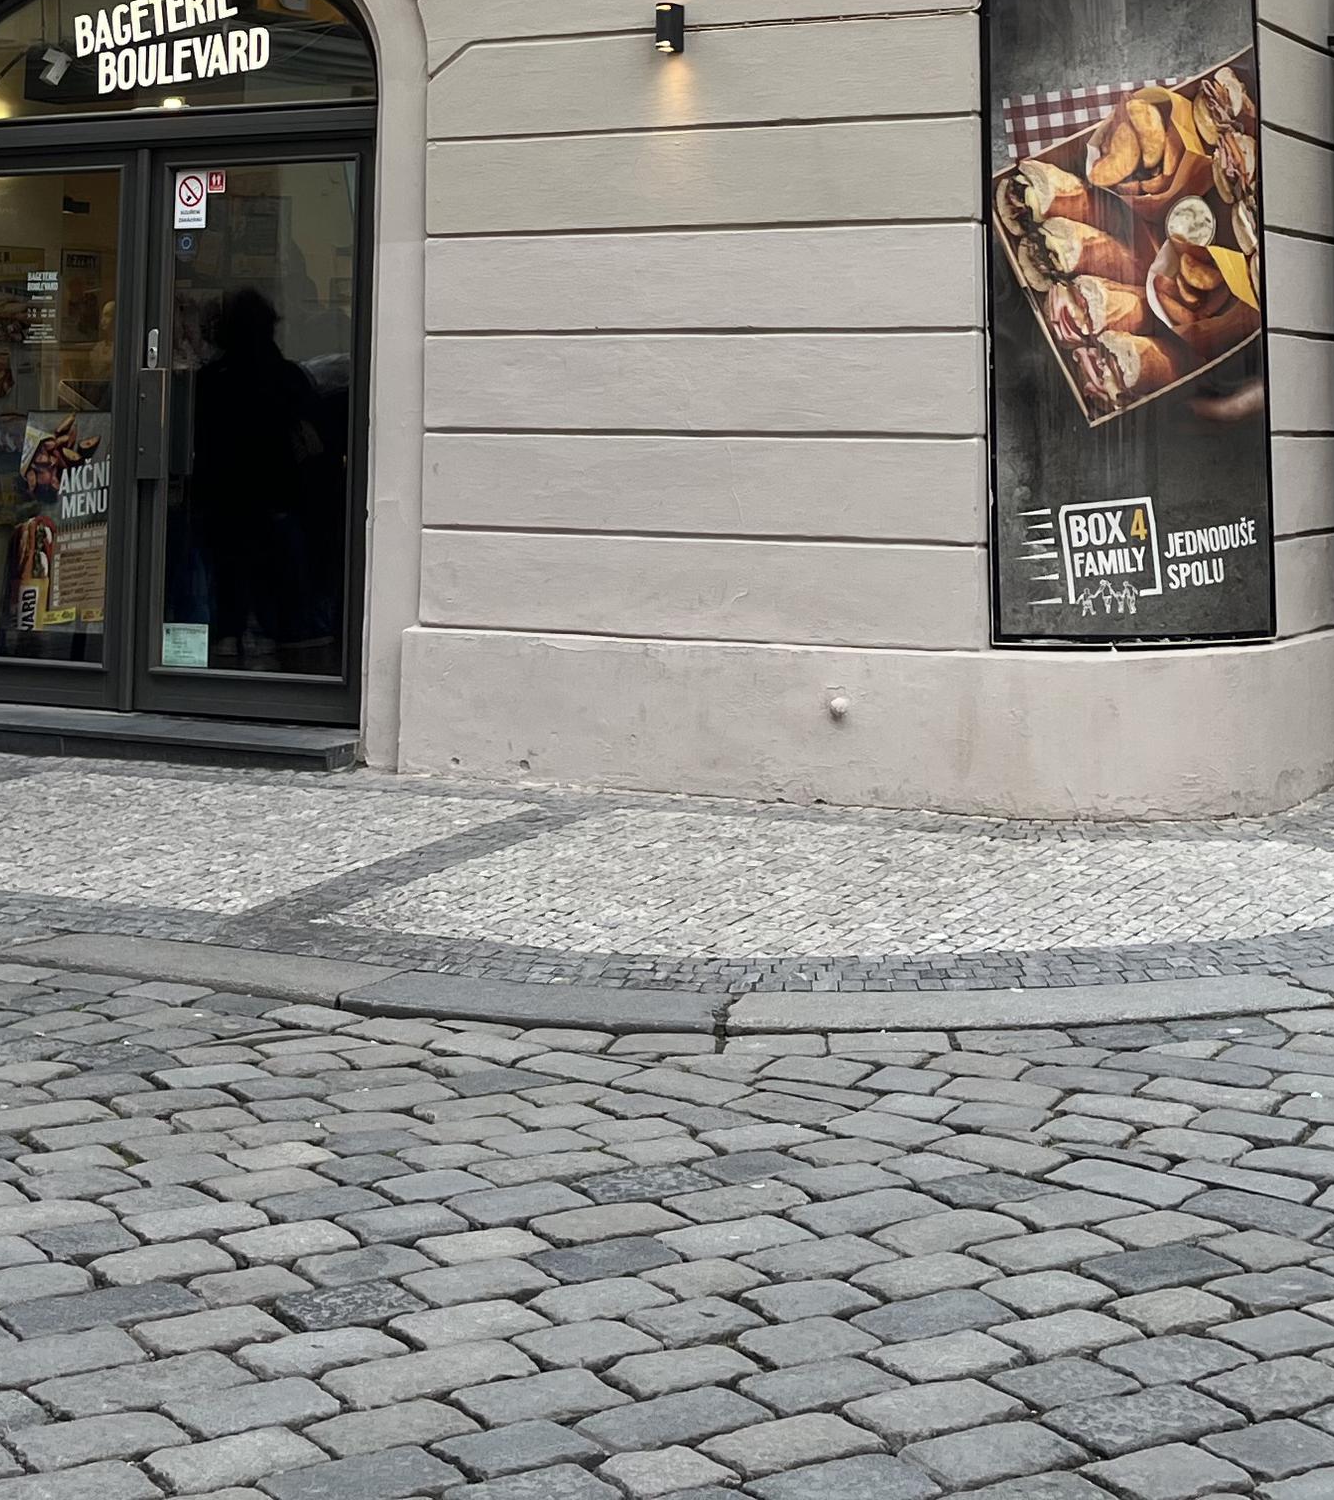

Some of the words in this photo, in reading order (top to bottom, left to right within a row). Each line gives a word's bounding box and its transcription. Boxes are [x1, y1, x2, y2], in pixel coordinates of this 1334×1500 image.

[98, 27, 270, 94] BOULEVARD
[58, 454, 110, 495] AKČNÍ
[61, 489, 108, 520] MENU
[1069, 511, 1127, 548] BOX
[1130, 508, 1148, 541] 4
[1164, 517, 1257, 559] JEDNODUŠE
[1074, 546, 1147, 579] FAMILY
[1167, 557, 1225, 590] SPOLU
